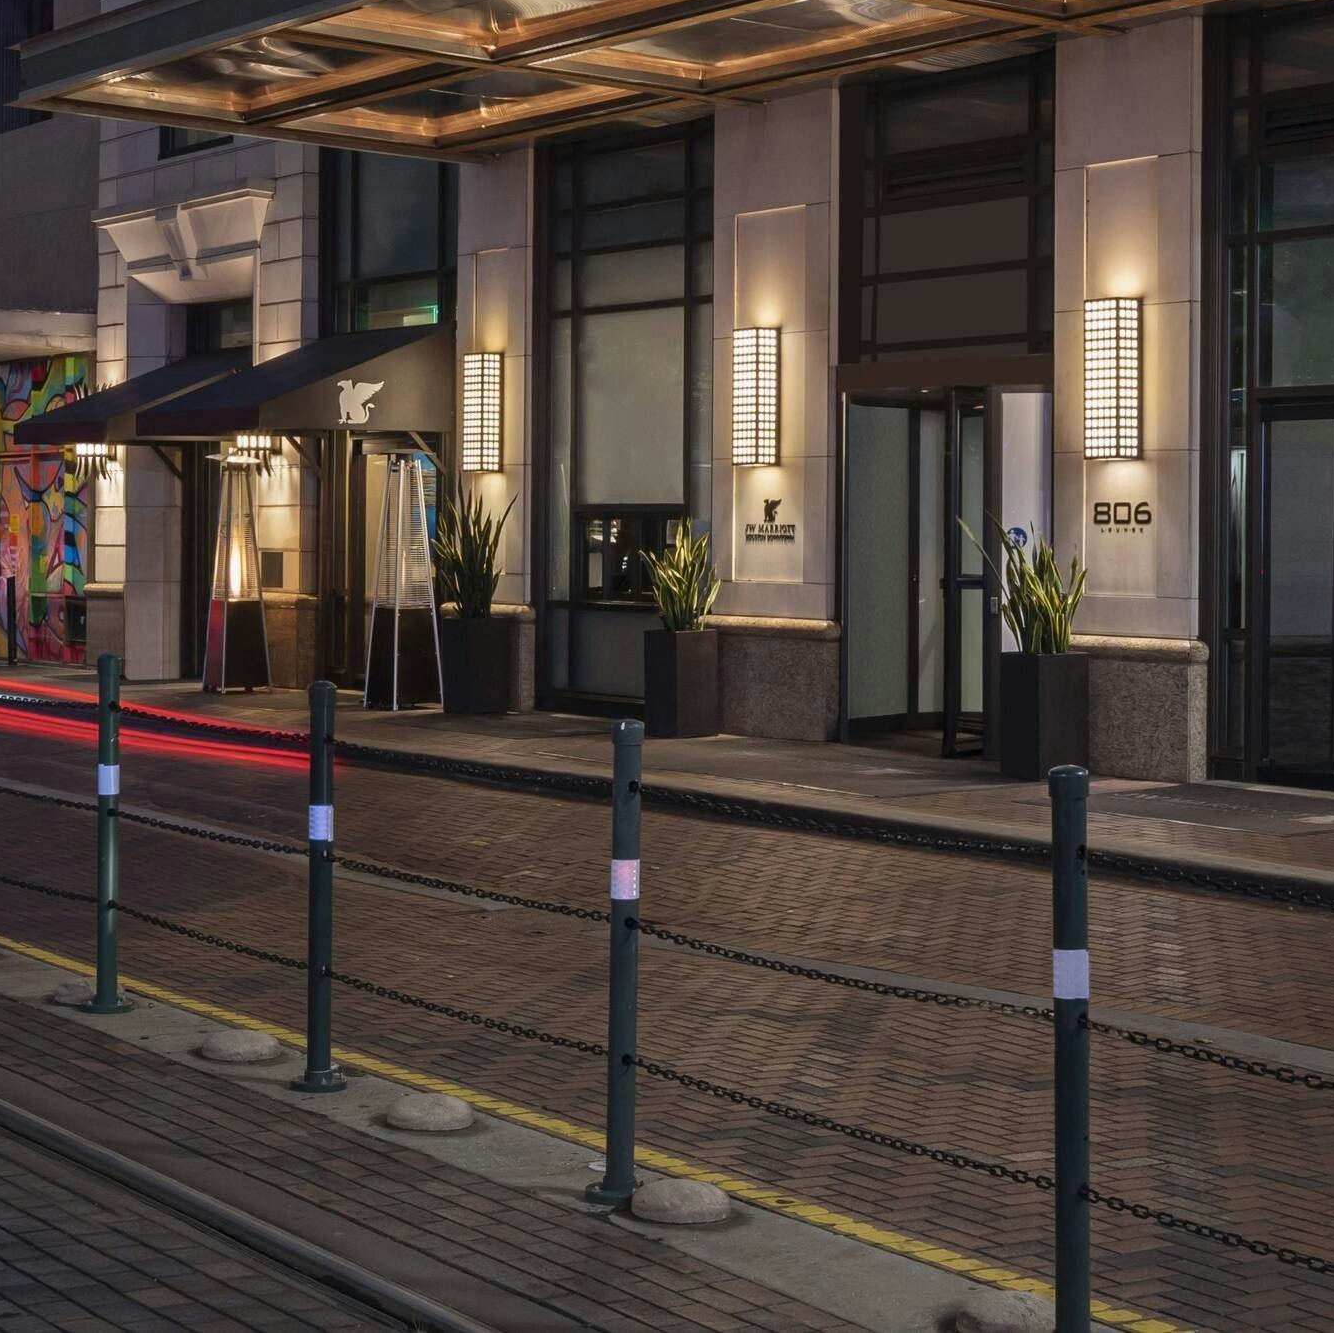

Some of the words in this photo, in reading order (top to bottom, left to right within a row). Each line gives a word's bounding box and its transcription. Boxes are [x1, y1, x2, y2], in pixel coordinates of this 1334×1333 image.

[1093, 501, 1152, 525] 806
[745, 524, 756, 534] JW
[758, 524, 796, 534] MARRIOTT
